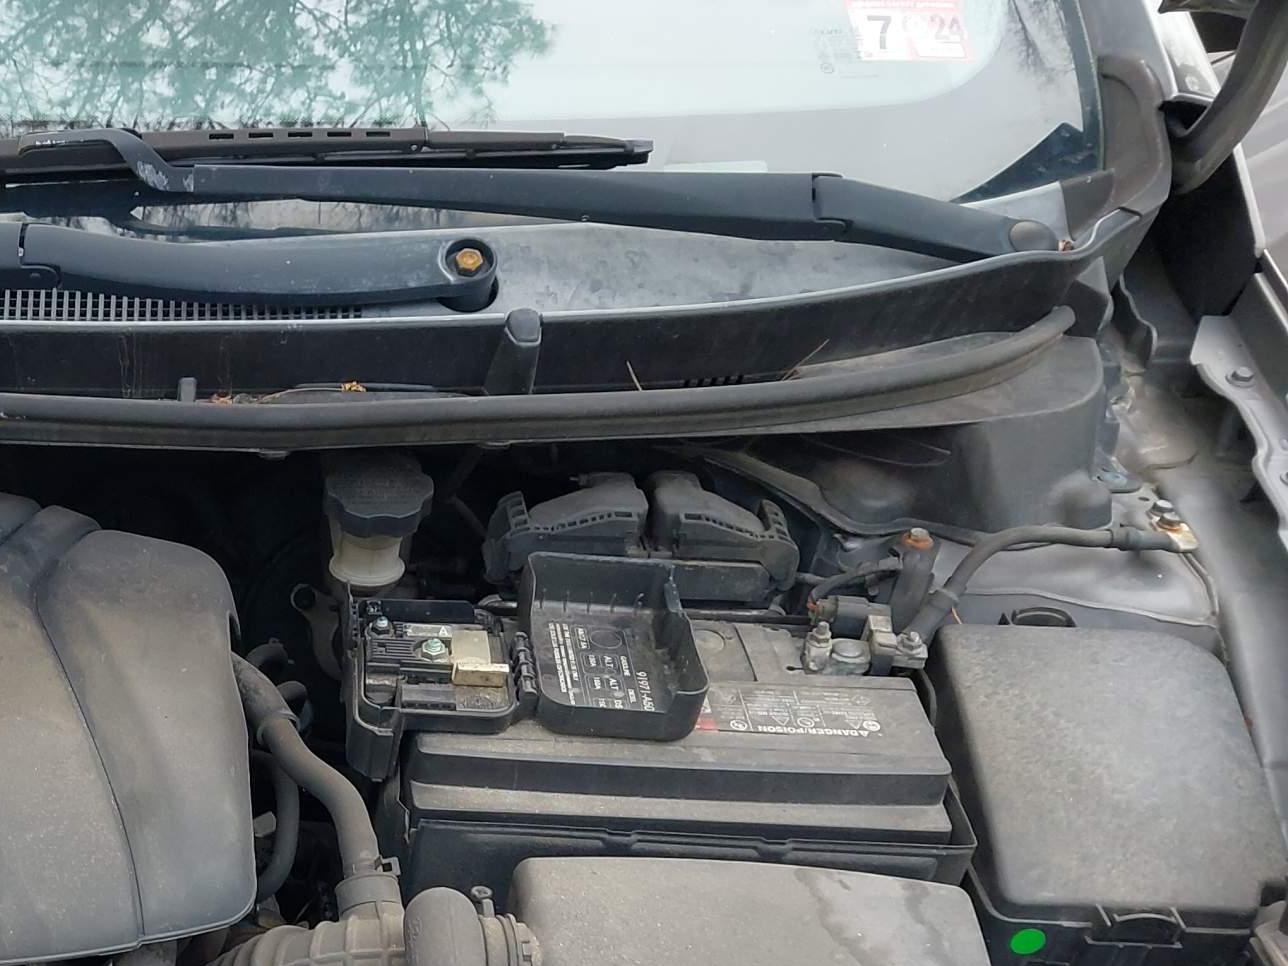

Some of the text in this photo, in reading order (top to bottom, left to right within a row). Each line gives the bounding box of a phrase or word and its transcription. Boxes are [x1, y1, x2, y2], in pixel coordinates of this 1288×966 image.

[866, 15, 892, 50] 7
[603, 655, 614, 668] ALT
[609, 677, 619, 690] ALT
[757, 725, 862, 737] DANGER/POISON
